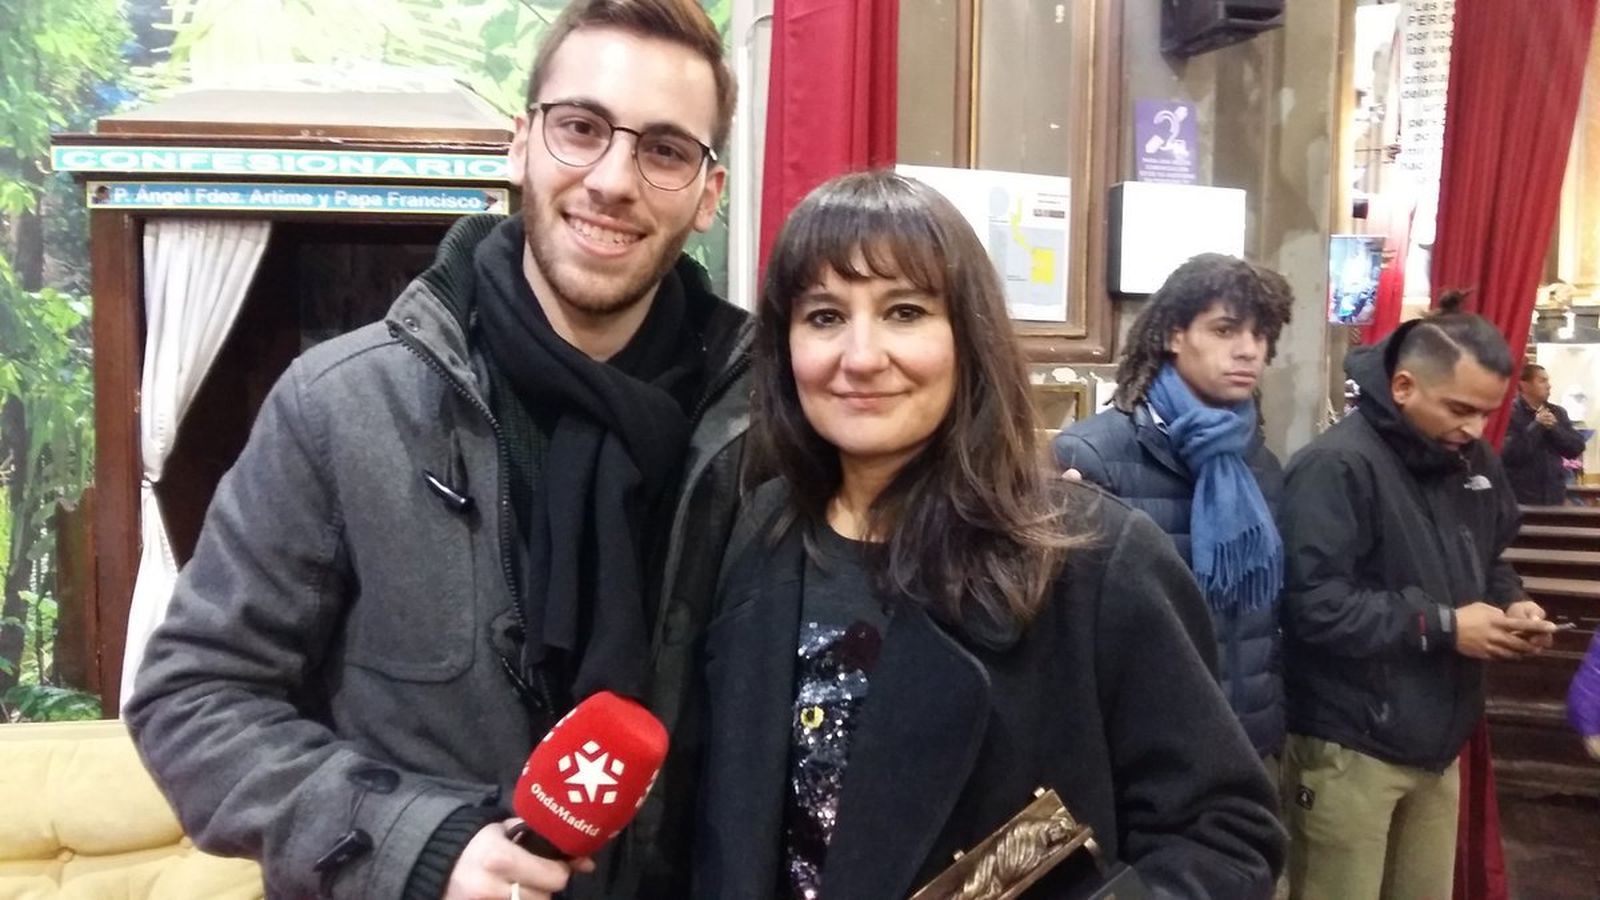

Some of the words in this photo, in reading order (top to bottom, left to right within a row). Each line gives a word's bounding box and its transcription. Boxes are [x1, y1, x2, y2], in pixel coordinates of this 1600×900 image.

[61, 151, 508, 176] CONFESIONARIO
[114, 187, 130, 203] P.
[135, 183, 190, 207] Ángel
[249, 188, 314, 206] Artime
[317, 193, 330, 209] y
[334, 189, 383, 209] Papa
[386, 190, 483, 210] Francisco
[531, 783, 599, 836] OndaMadrid
